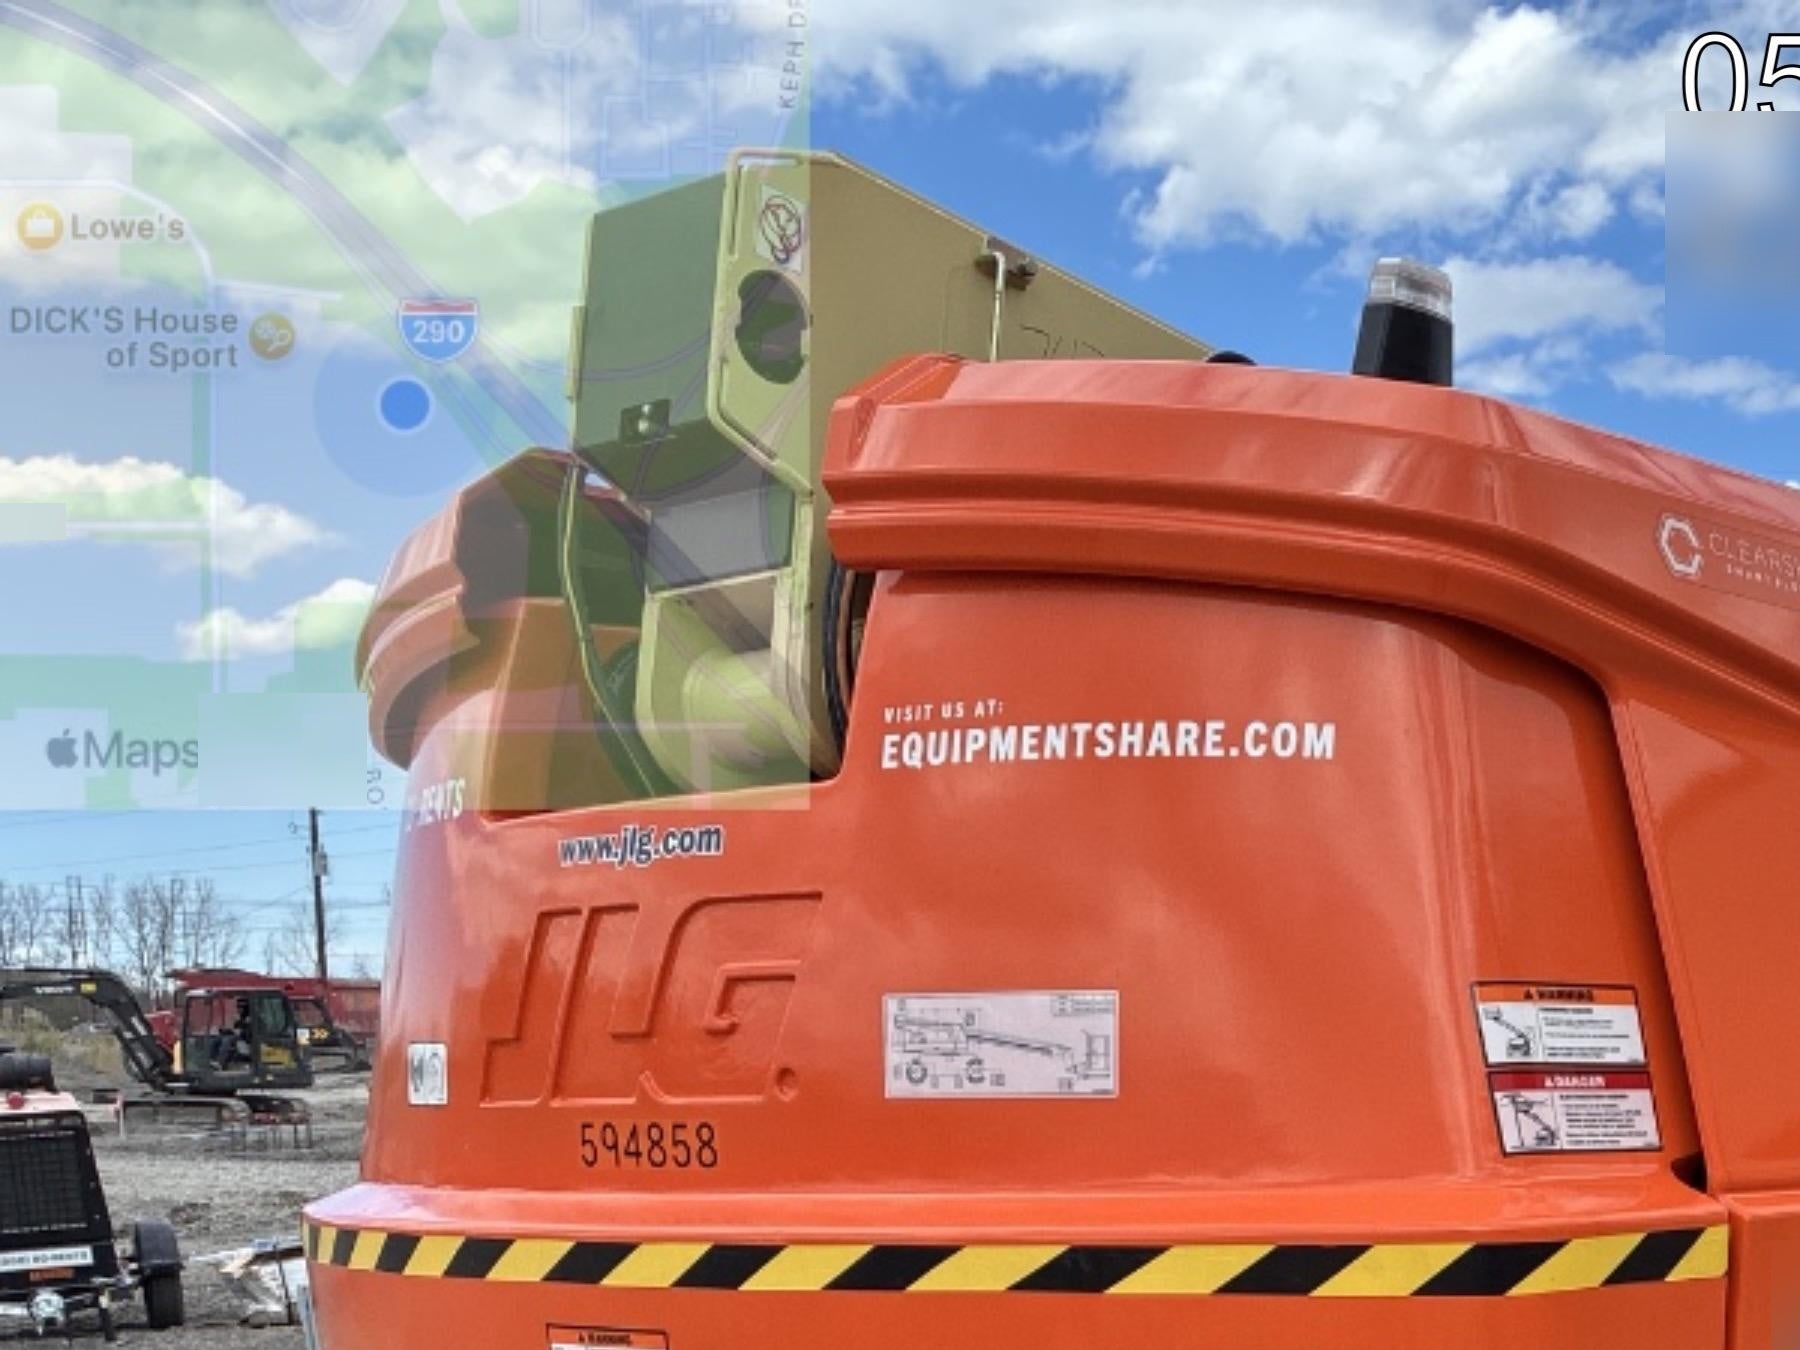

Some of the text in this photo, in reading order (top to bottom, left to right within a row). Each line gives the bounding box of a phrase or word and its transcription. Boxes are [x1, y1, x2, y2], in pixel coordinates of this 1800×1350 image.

[883, 698, 1004, 724] VISIT US AT:
[880, 720, 1337, 770] EQUIPMENTSHARE.COM
[558, 824, 726, 869] www.jlg.com
[480, 890, 824, 1108] JLG
[579, 1121, 719, 1169] 594858
